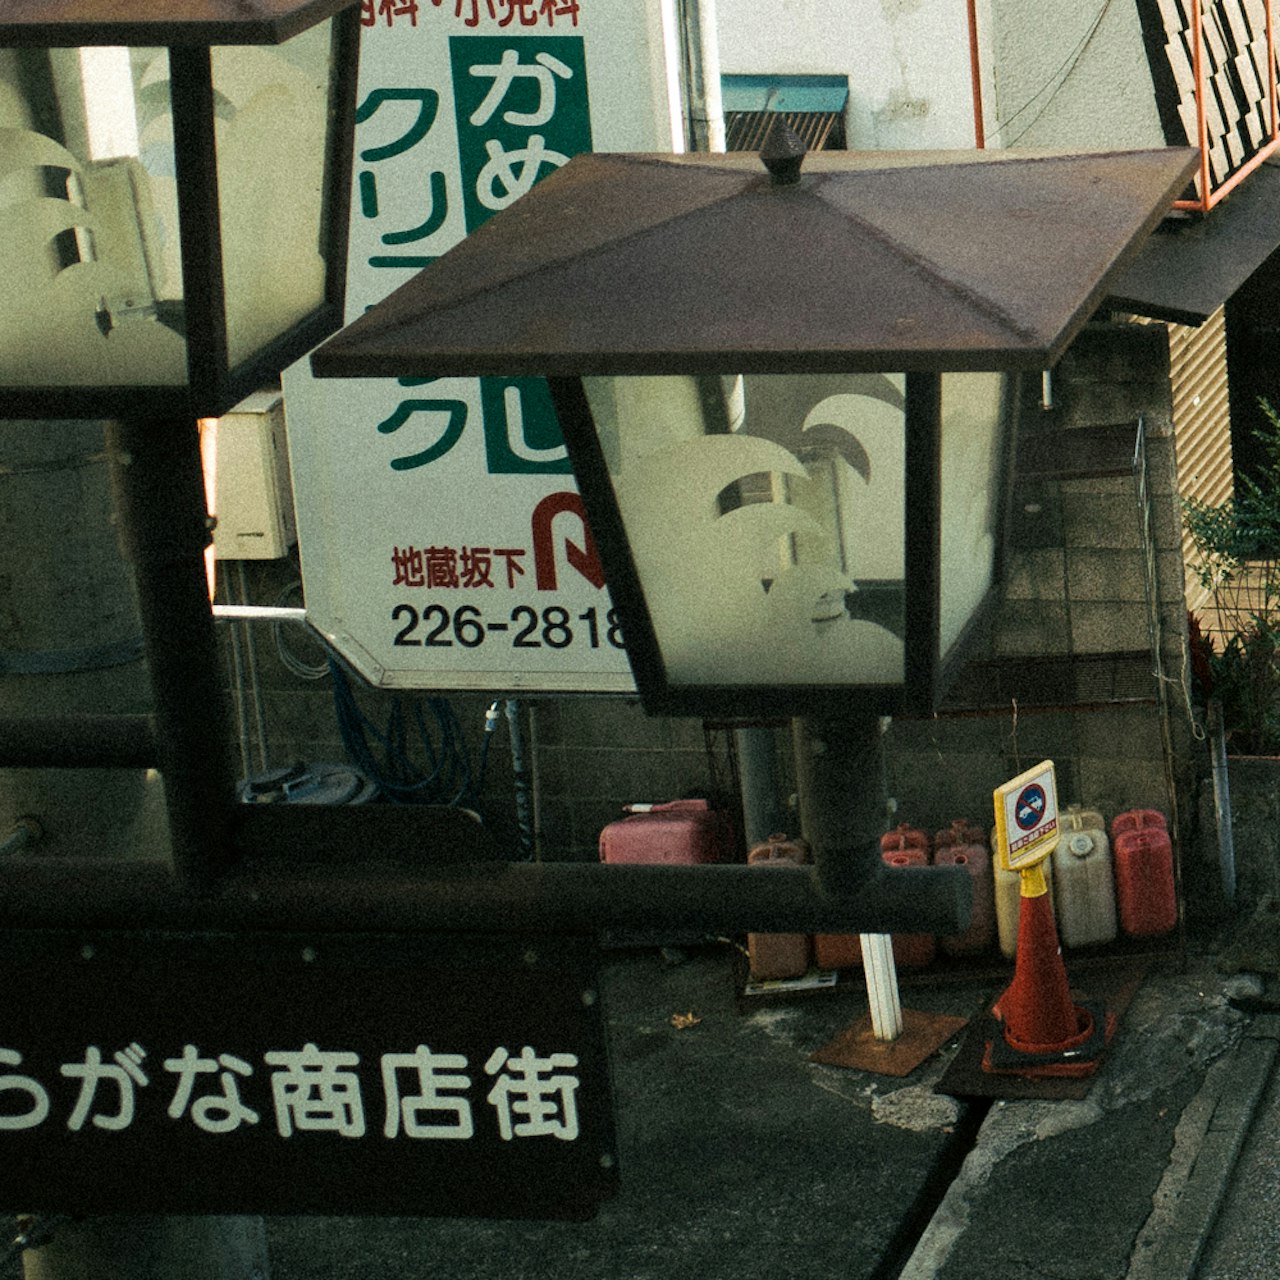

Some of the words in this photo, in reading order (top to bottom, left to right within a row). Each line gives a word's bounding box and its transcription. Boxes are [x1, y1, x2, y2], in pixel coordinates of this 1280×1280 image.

[468, 48, 574, 463] かめし
[390, 546, 526, 591] 地蔵坂下
